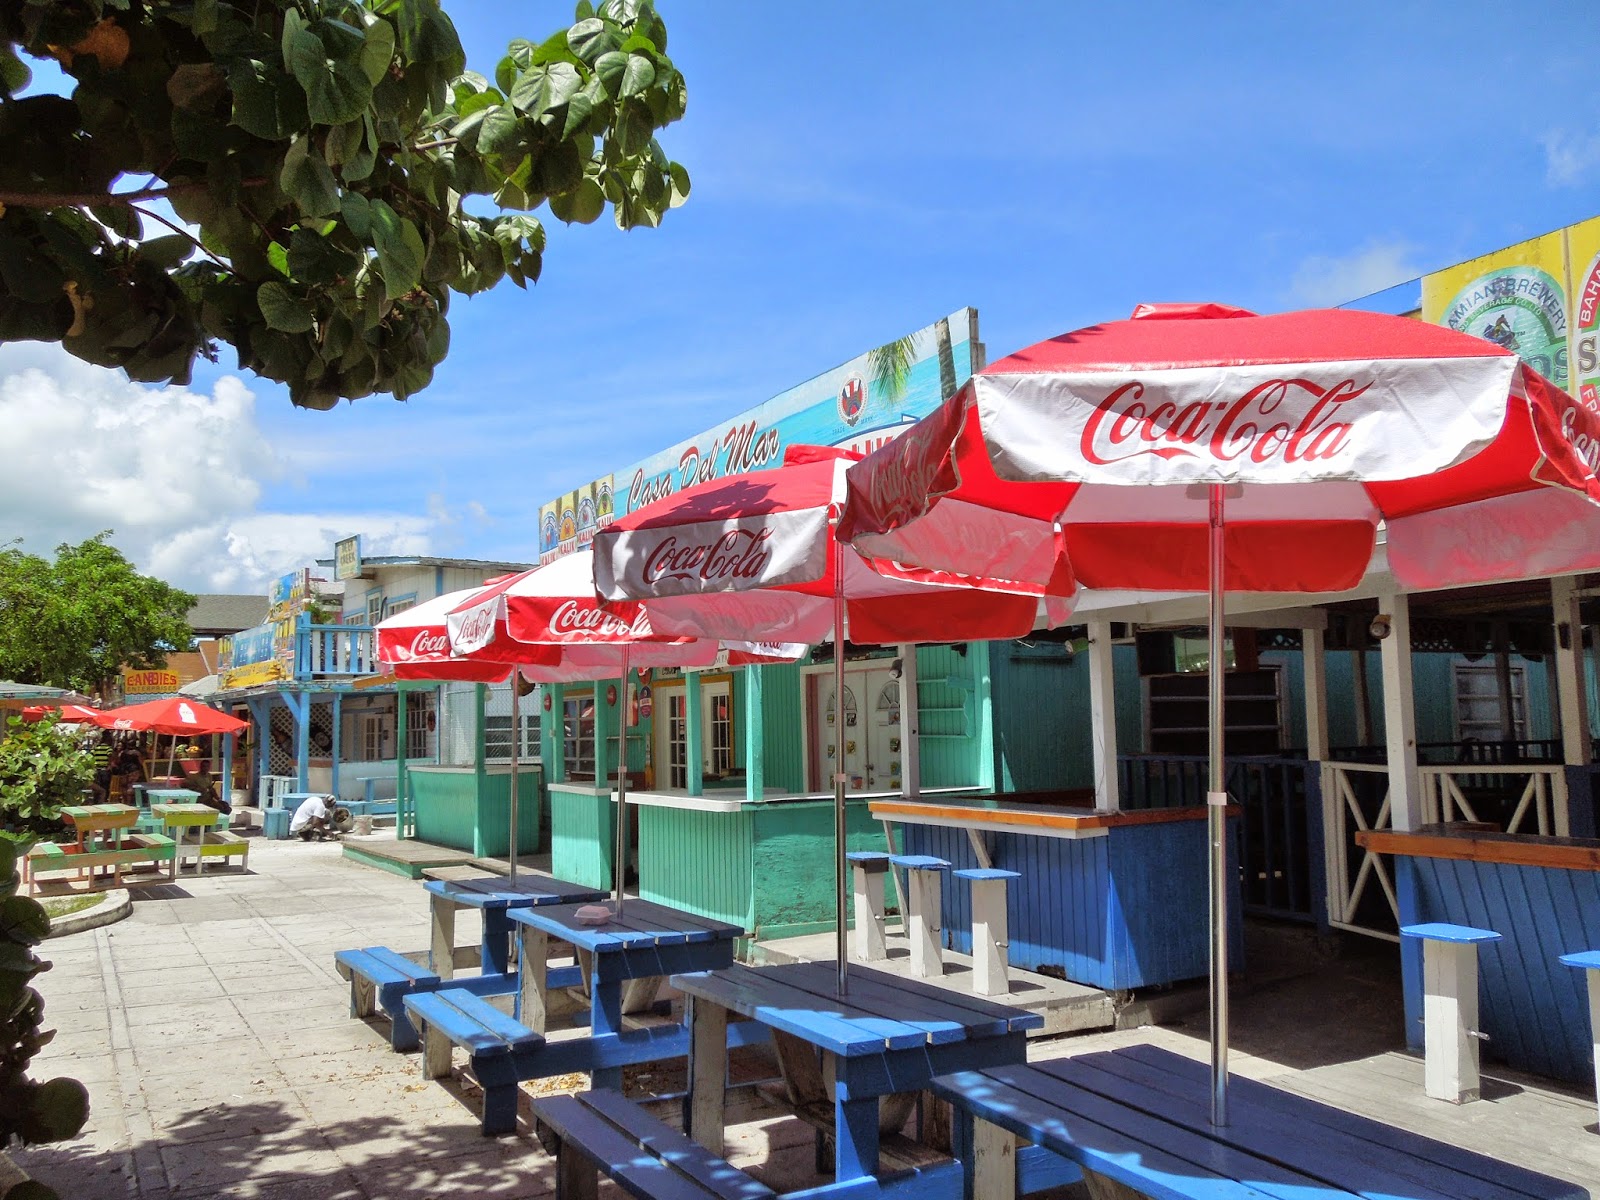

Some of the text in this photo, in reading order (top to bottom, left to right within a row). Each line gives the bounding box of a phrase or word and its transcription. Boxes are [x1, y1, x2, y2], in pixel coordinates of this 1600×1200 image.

[1448, 278, 1567, 332] AMIAN BREWERY
[1080, 379, 1376, 465] Coca-Cola
[627, 419, 780, 515] Casa Del Mar
[642, 526, 776, 585] Coca-Cola
[410, 630, 447, 658] Coca
[127, 671, 177, 686] CANDIES
